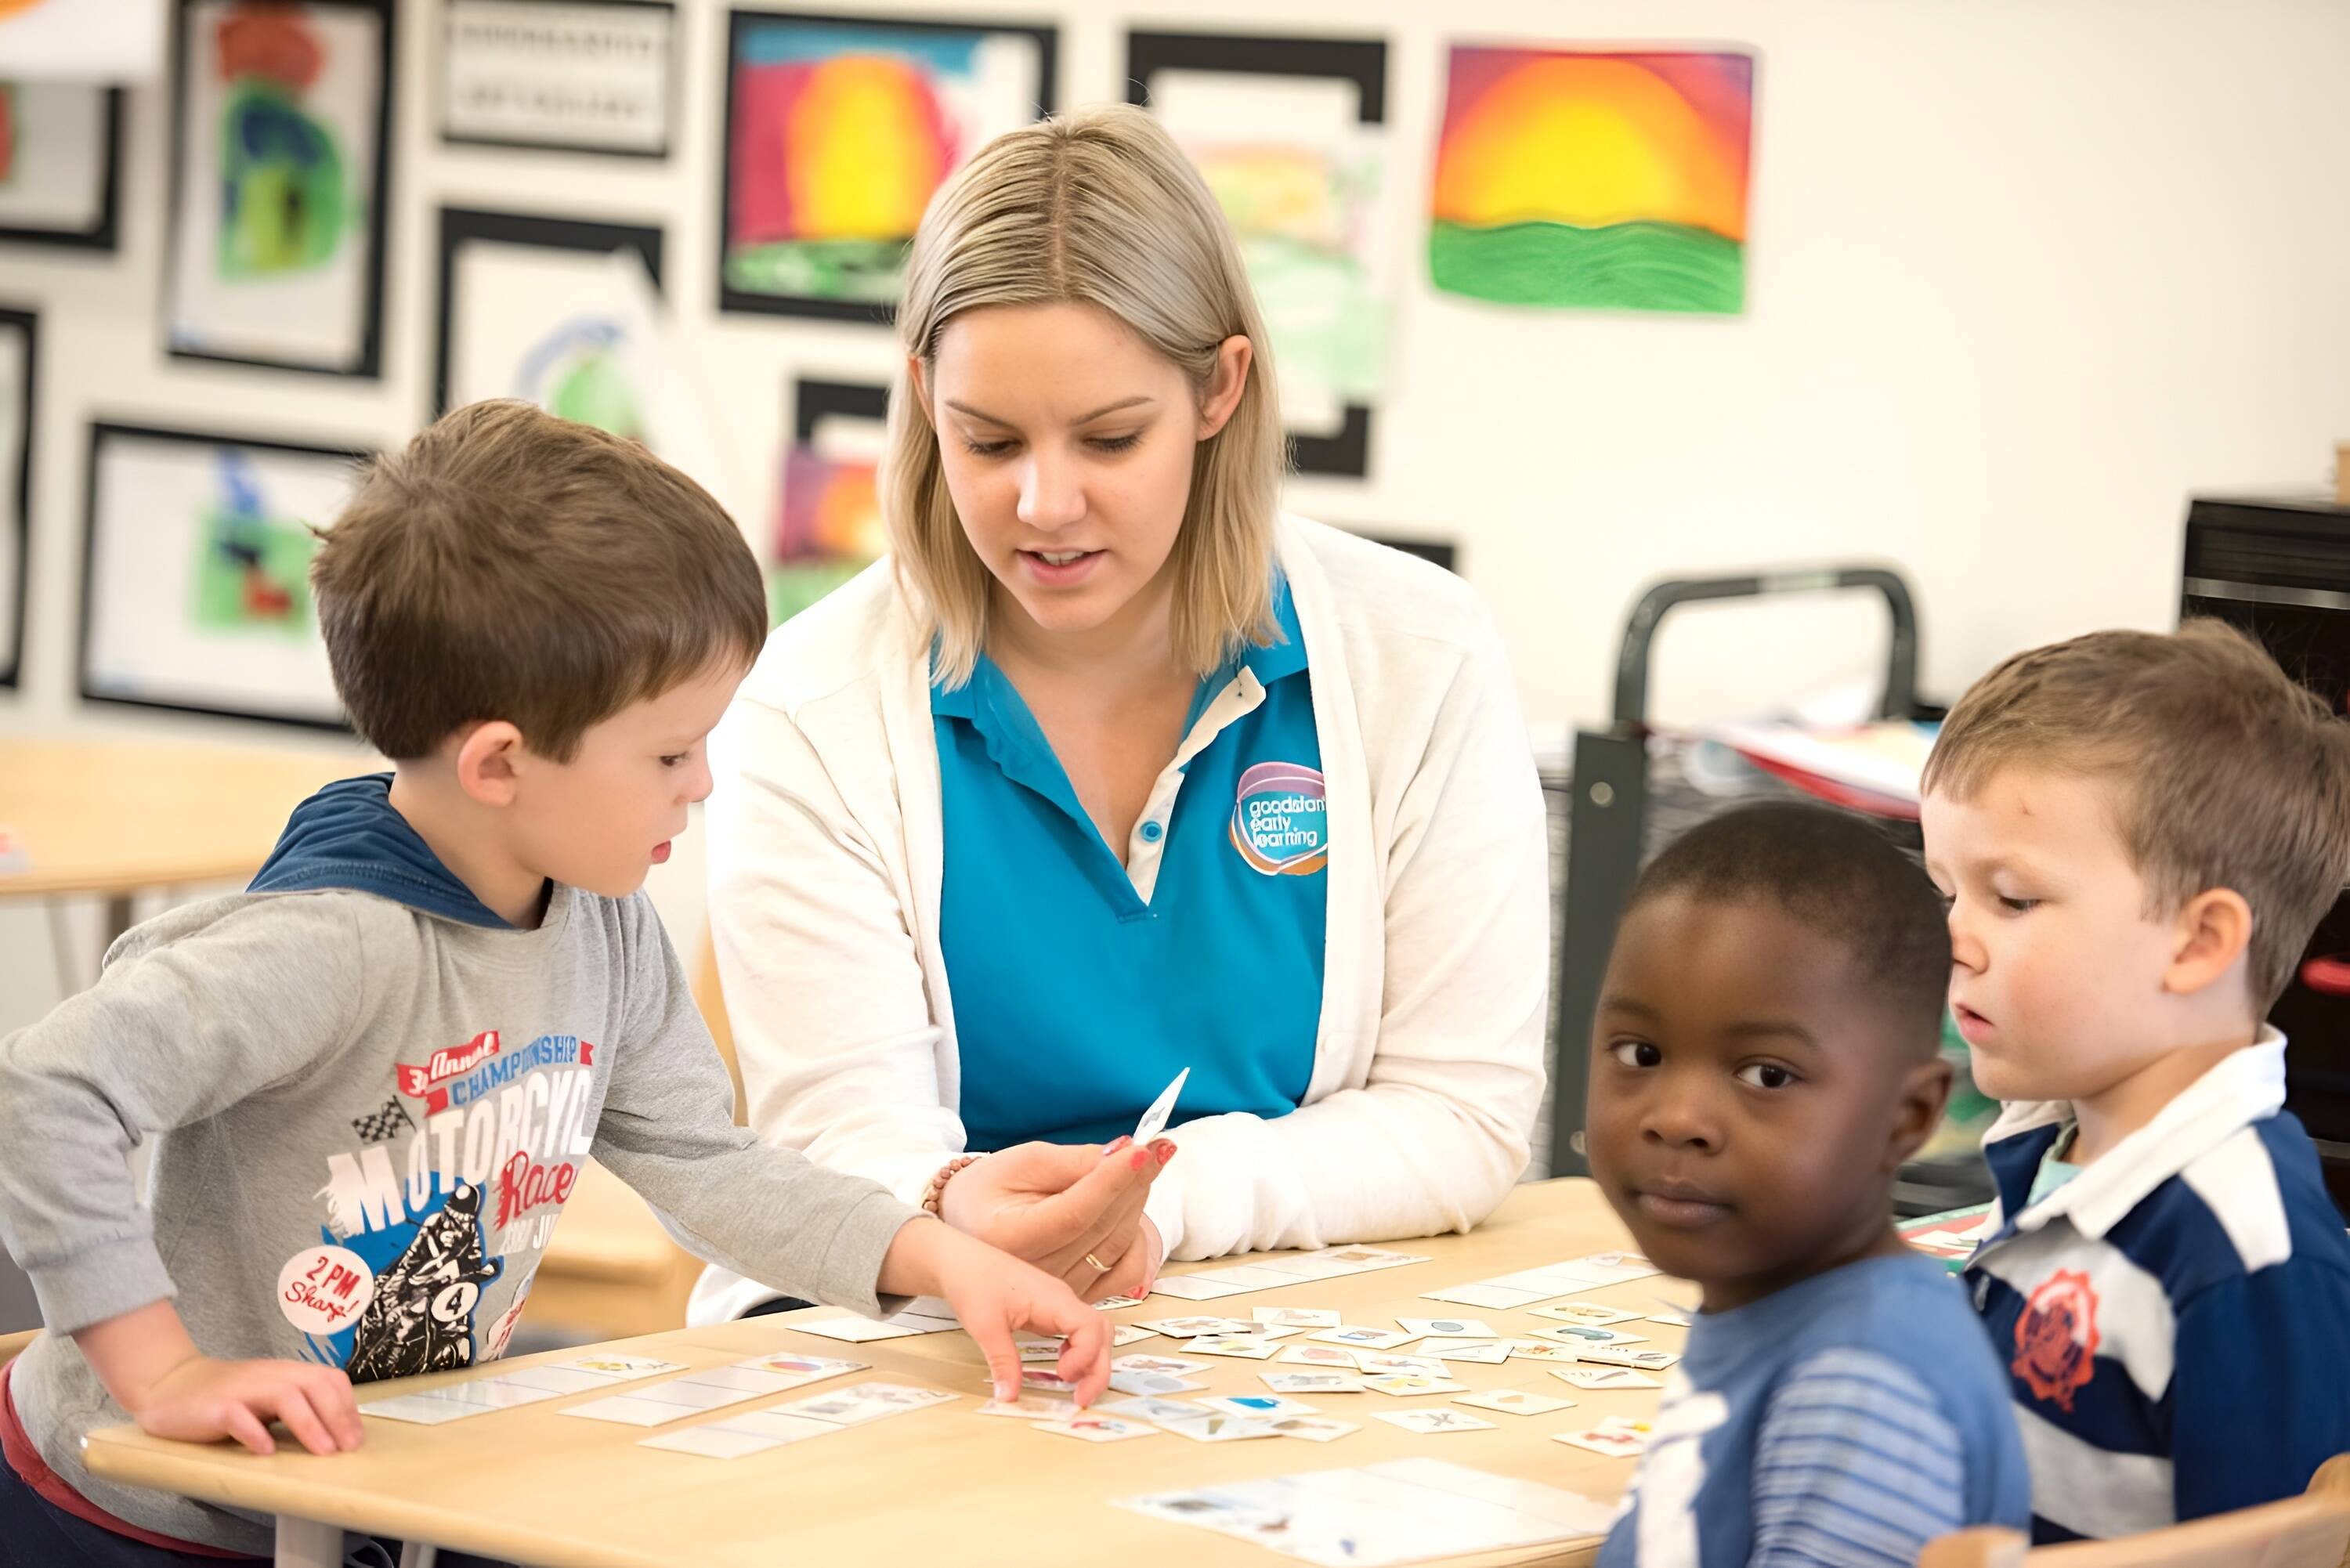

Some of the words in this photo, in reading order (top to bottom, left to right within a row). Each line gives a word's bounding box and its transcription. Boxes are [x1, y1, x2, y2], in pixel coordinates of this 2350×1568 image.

[1249, 815, 1292, 833] early
[1253, 826, 1318, 847] learning
[306, 1255, 329, 1281] 2
[321, 1263, 361, 1300] PM
[445, 1287, 464, 1315] 4
